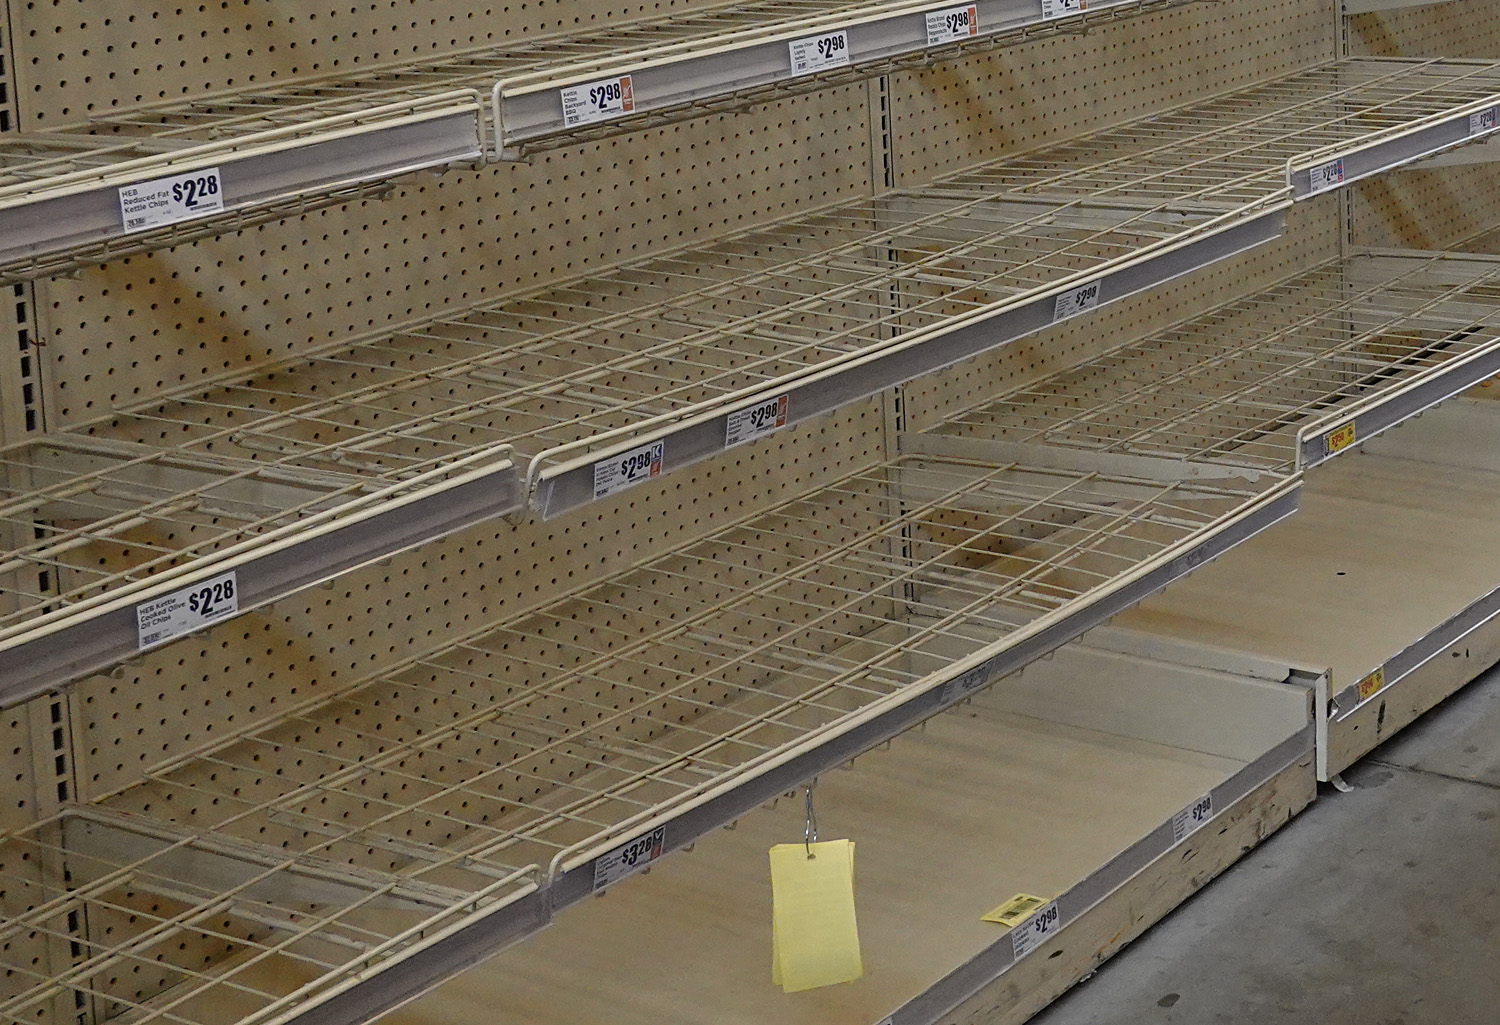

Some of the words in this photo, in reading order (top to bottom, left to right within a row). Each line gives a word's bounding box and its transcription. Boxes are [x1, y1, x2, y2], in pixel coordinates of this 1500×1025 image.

[946, 12, 968, 33] $298
[818, 35, 845, 59] $298
[564, 96, 577, 104] Chips
[565, 100, 587, 110] Backyard
[590, 82, 621, 109] $298
[122, 188, 138, 198] HEB
[123, 191, 156, 205] Reduced
[157, 190, 170, 199] Fat
[172, 175, 219, 207] $228
[124, 201, 147, 214] Kettle
[148, 199, 169, 210] Chips
[1076, 286, 1097, 306] $298
[751, 402, 778, 428] $298
[621, 451, 651, 479] $298
[140, 605, 155, 616] HEB
[156, 597, 177, 611] Kettle
[190, 580, 234, 616] $228
[140, 609, 168, 623] Cooked
[168, 602, 187, 614] Olive
[141, 620, 152, 630] Oil
[152, 615, 172, 626] Chips
[1192, 797, 1211, 821] $298
[622, 836, 652, 866] $328
[1035, 905, 1057, 933] $298
